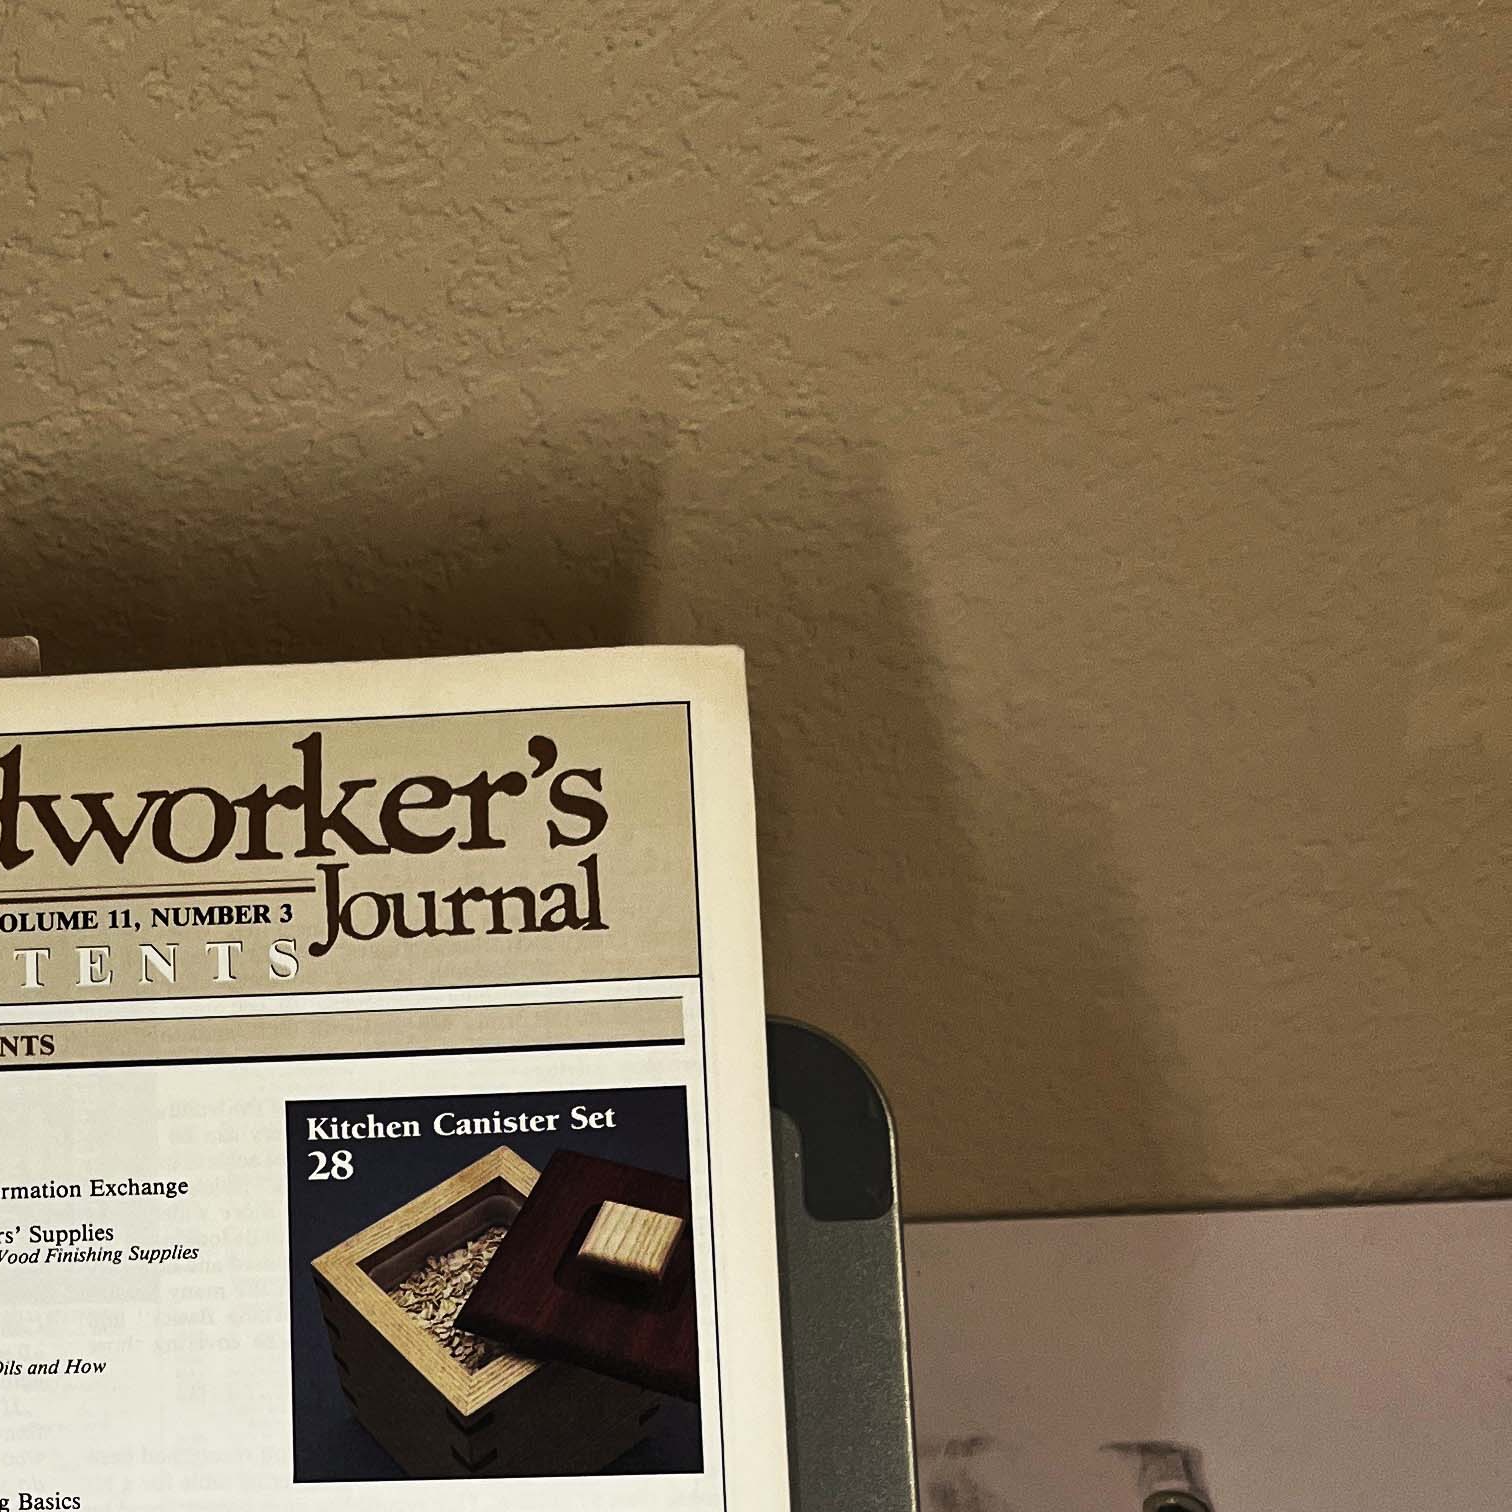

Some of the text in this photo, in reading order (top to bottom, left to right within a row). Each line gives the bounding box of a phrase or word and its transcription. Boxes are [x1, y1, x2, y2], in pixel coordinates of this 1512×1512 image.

[308, 853, 609, 957] Journal
[107, 908, 141, 933] 11,
[150, 903, 272, 929] NUMBER
[279, 903, 293, 924] 3
[306, 1105, 617, 1141] Kitchen Canister Set
[307, 1149, 355, 1181] 28
[89, 1177, 189, 1199] Exchange
[28, 1222, 115, 1247] Supplies
[43, 1246, 124, 1266] Finishing
[127, 1243, 200, 1265] Supplies
[26, 1358, 61, 1376] and
[63, 1358, 107, 1375] How
[17, 1491, 81, 1511] Basics
